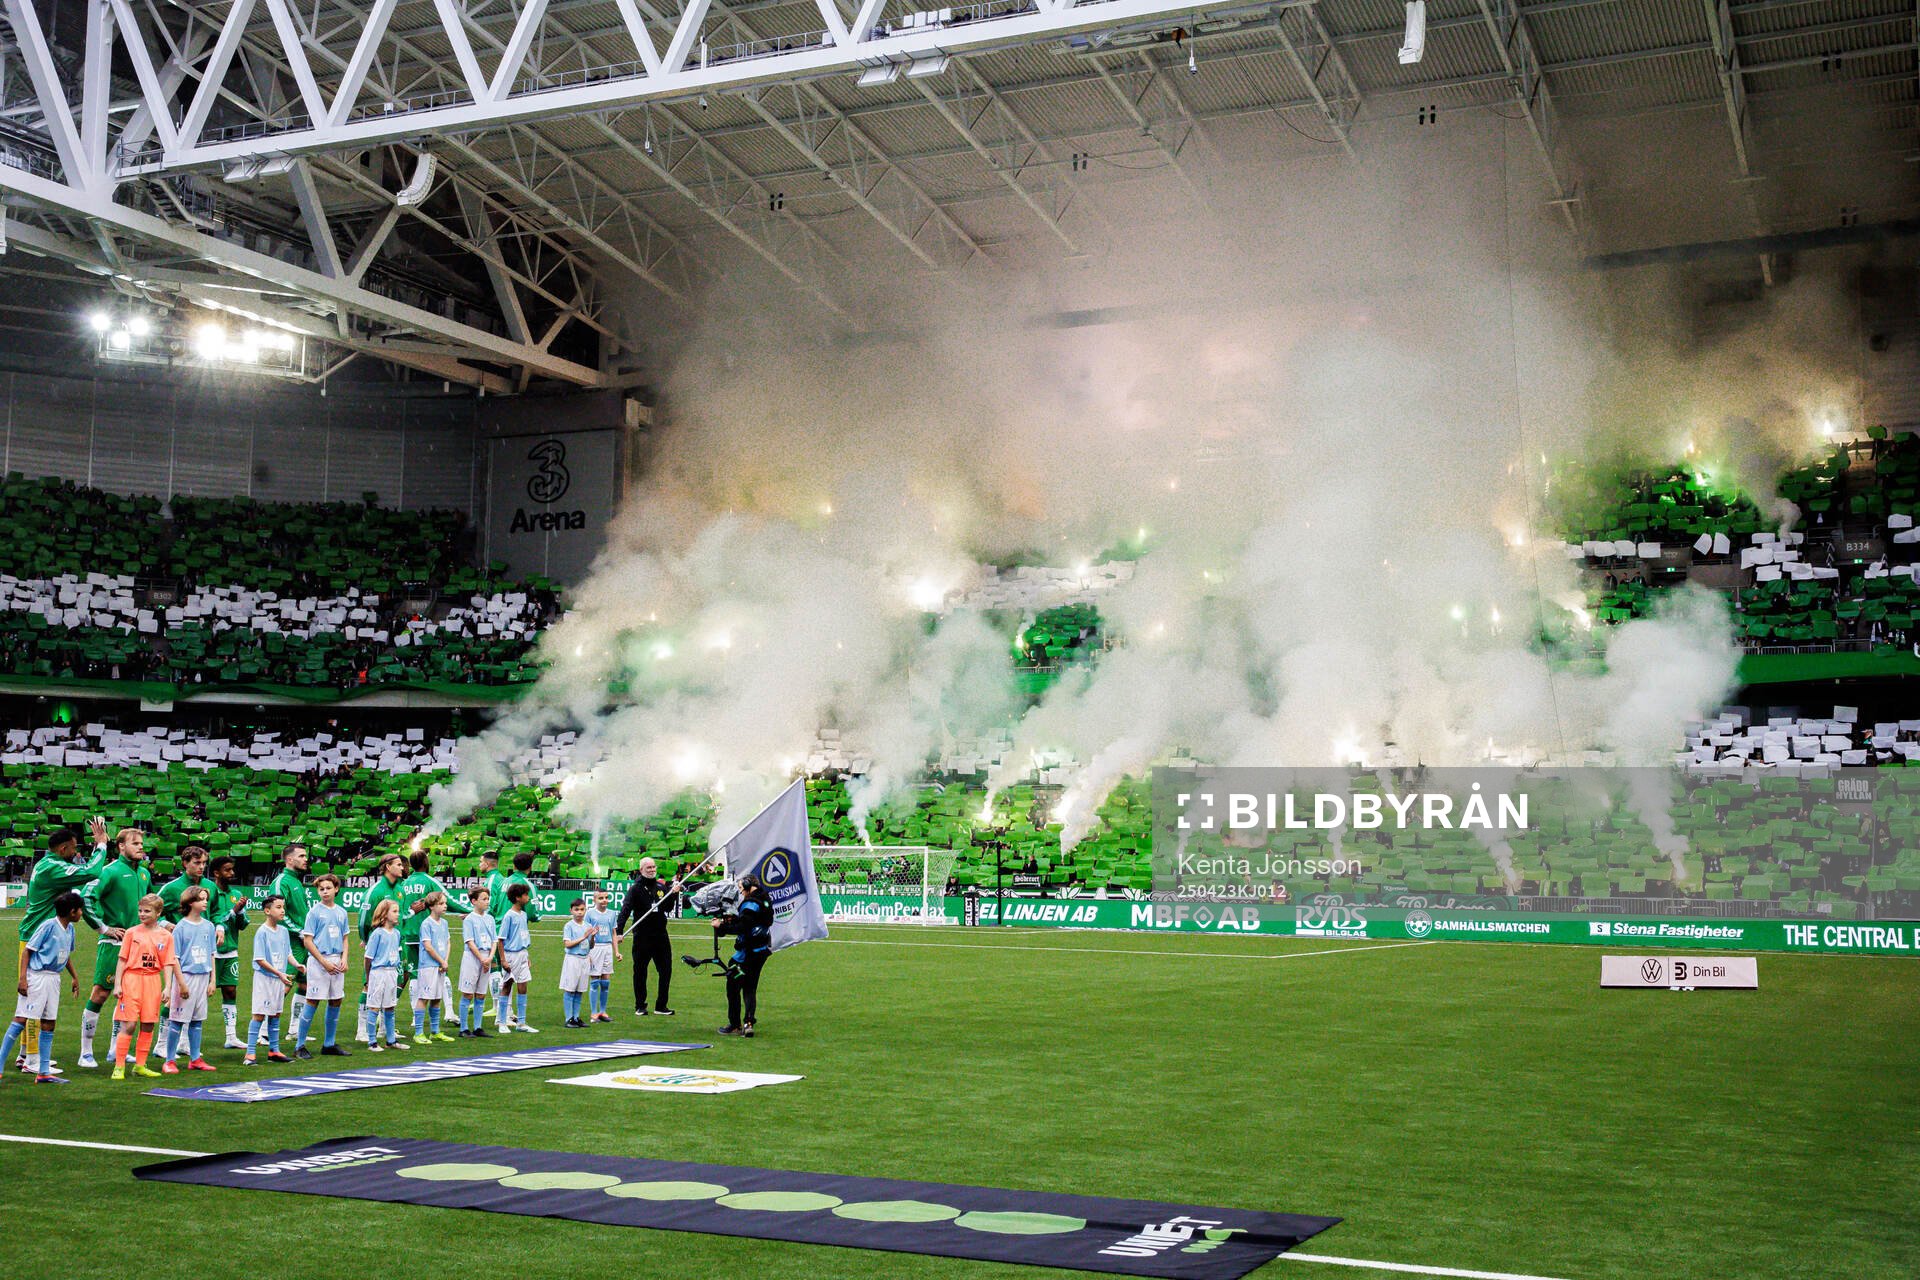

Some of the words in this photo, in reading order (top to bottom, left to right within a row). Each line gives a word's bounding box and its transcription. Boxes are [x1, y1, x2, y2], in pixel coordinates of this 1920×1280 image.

[510, 508, 585, 534] Arena
[404, 884, 426, 895] BAJEN
[1003, 904, 1070, 921] LINJEN
[1070, 906, 1099, 922] AB
[1131, 904, 1190, 928] MBF
[1217, 906, 1260, 930] AB
[1295, 905, 1367, 929] RYDS
[1434, 919, 1550, 933] SAMHÄLLSMATCHEN
[1613, 922, 1657, 935] Stena
[1659, 924, 1744, 938] Fastigheter
[1783, 924, 1819, 946] THE
[1823, 926, 1909, 949] CENTRAL
[1693, 966, 1711, 976] Din
[1713, 966, 1726, 976] Bil
